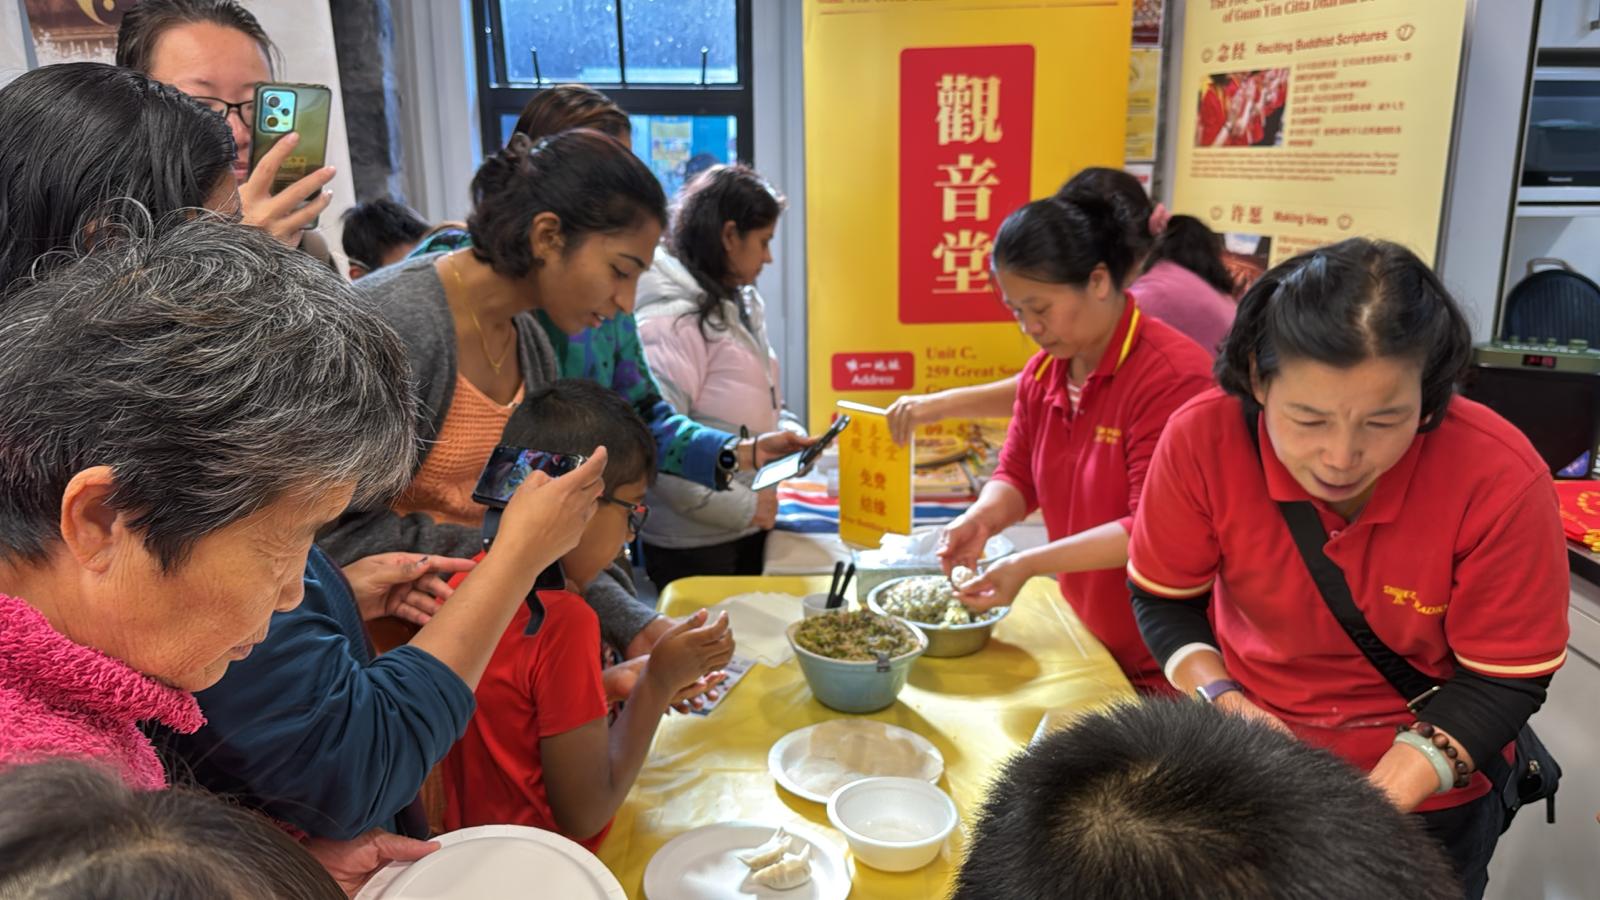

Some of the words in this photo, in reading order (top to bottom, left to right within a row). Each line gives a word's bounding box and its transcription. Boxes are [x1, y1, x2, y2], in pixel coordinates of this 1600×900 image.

[1222, 8, 1233, 22] of
[1263, 3, 1282, 17] Yin
[1256, 42, 1293, 54] Reciting
[1296, 37, 1335, 51] Buddhist
[1336, 31, 1387, 46] Scriptures
[932, 74, 1003, 294] 觀音堂
[1274, 210, 1303, 226] Making
[1305, 212, 1328, 226] Vows
[926, 346, 956, 360] Unit
[851, 373, 895, 386] Address
[927, 365, 950, 378] 259
[954, 365, 994, 378] Great
